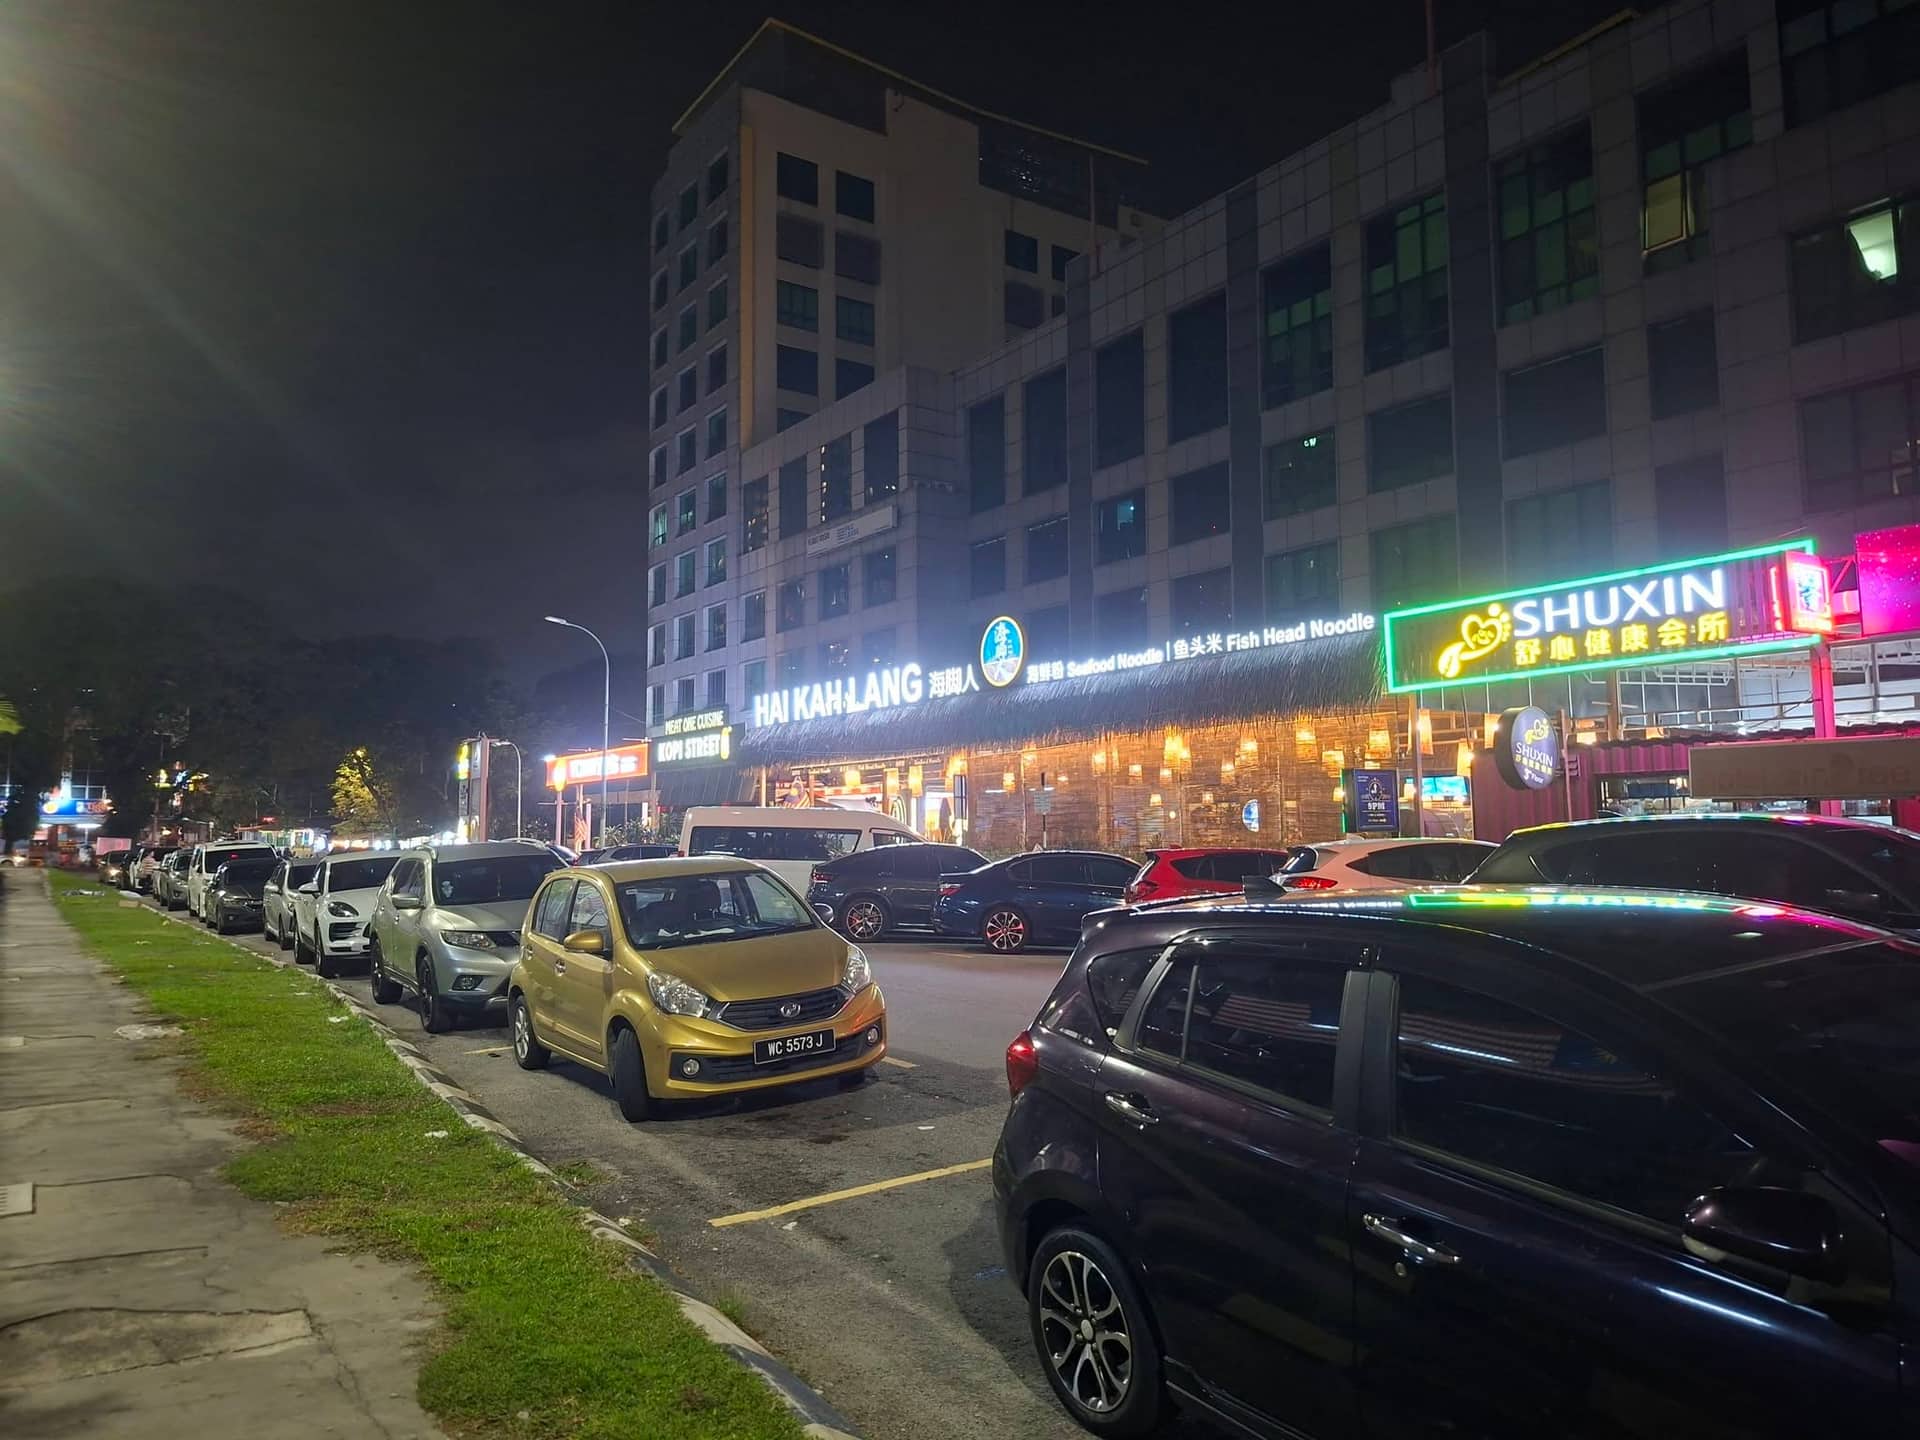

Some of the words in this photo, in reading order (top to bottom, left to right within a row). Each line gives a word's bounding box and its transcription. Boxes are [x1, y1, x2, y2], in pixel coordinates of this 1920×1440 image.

[1513, 568, 1725, 637] SHUXIN
[1066, 654, 1116, 678] Seafood
[1116, 648, 1164, 670] Noodle
[1226, 630, 1260, 652] Fish
[1263, 621, 1306, 646] Head
[1310, 612, 1376, 639] Noodle
[1514, 610, 1728, 667] 舒心健康会所
[754, 689, 789, 727] HAI
[793, 677, 842, 722] KAH
[846, 662, 923, 714] LANG
[658, 739, 683, 762] KOPI
[684, 734, 721, 760] STREET
[1515, 742, 1553, 767] SHUXIN
[768, 1041, 783, 1057] WC
[786, 1036, 813, 1052] 5573
[816, 1033, 823, 1047] J
